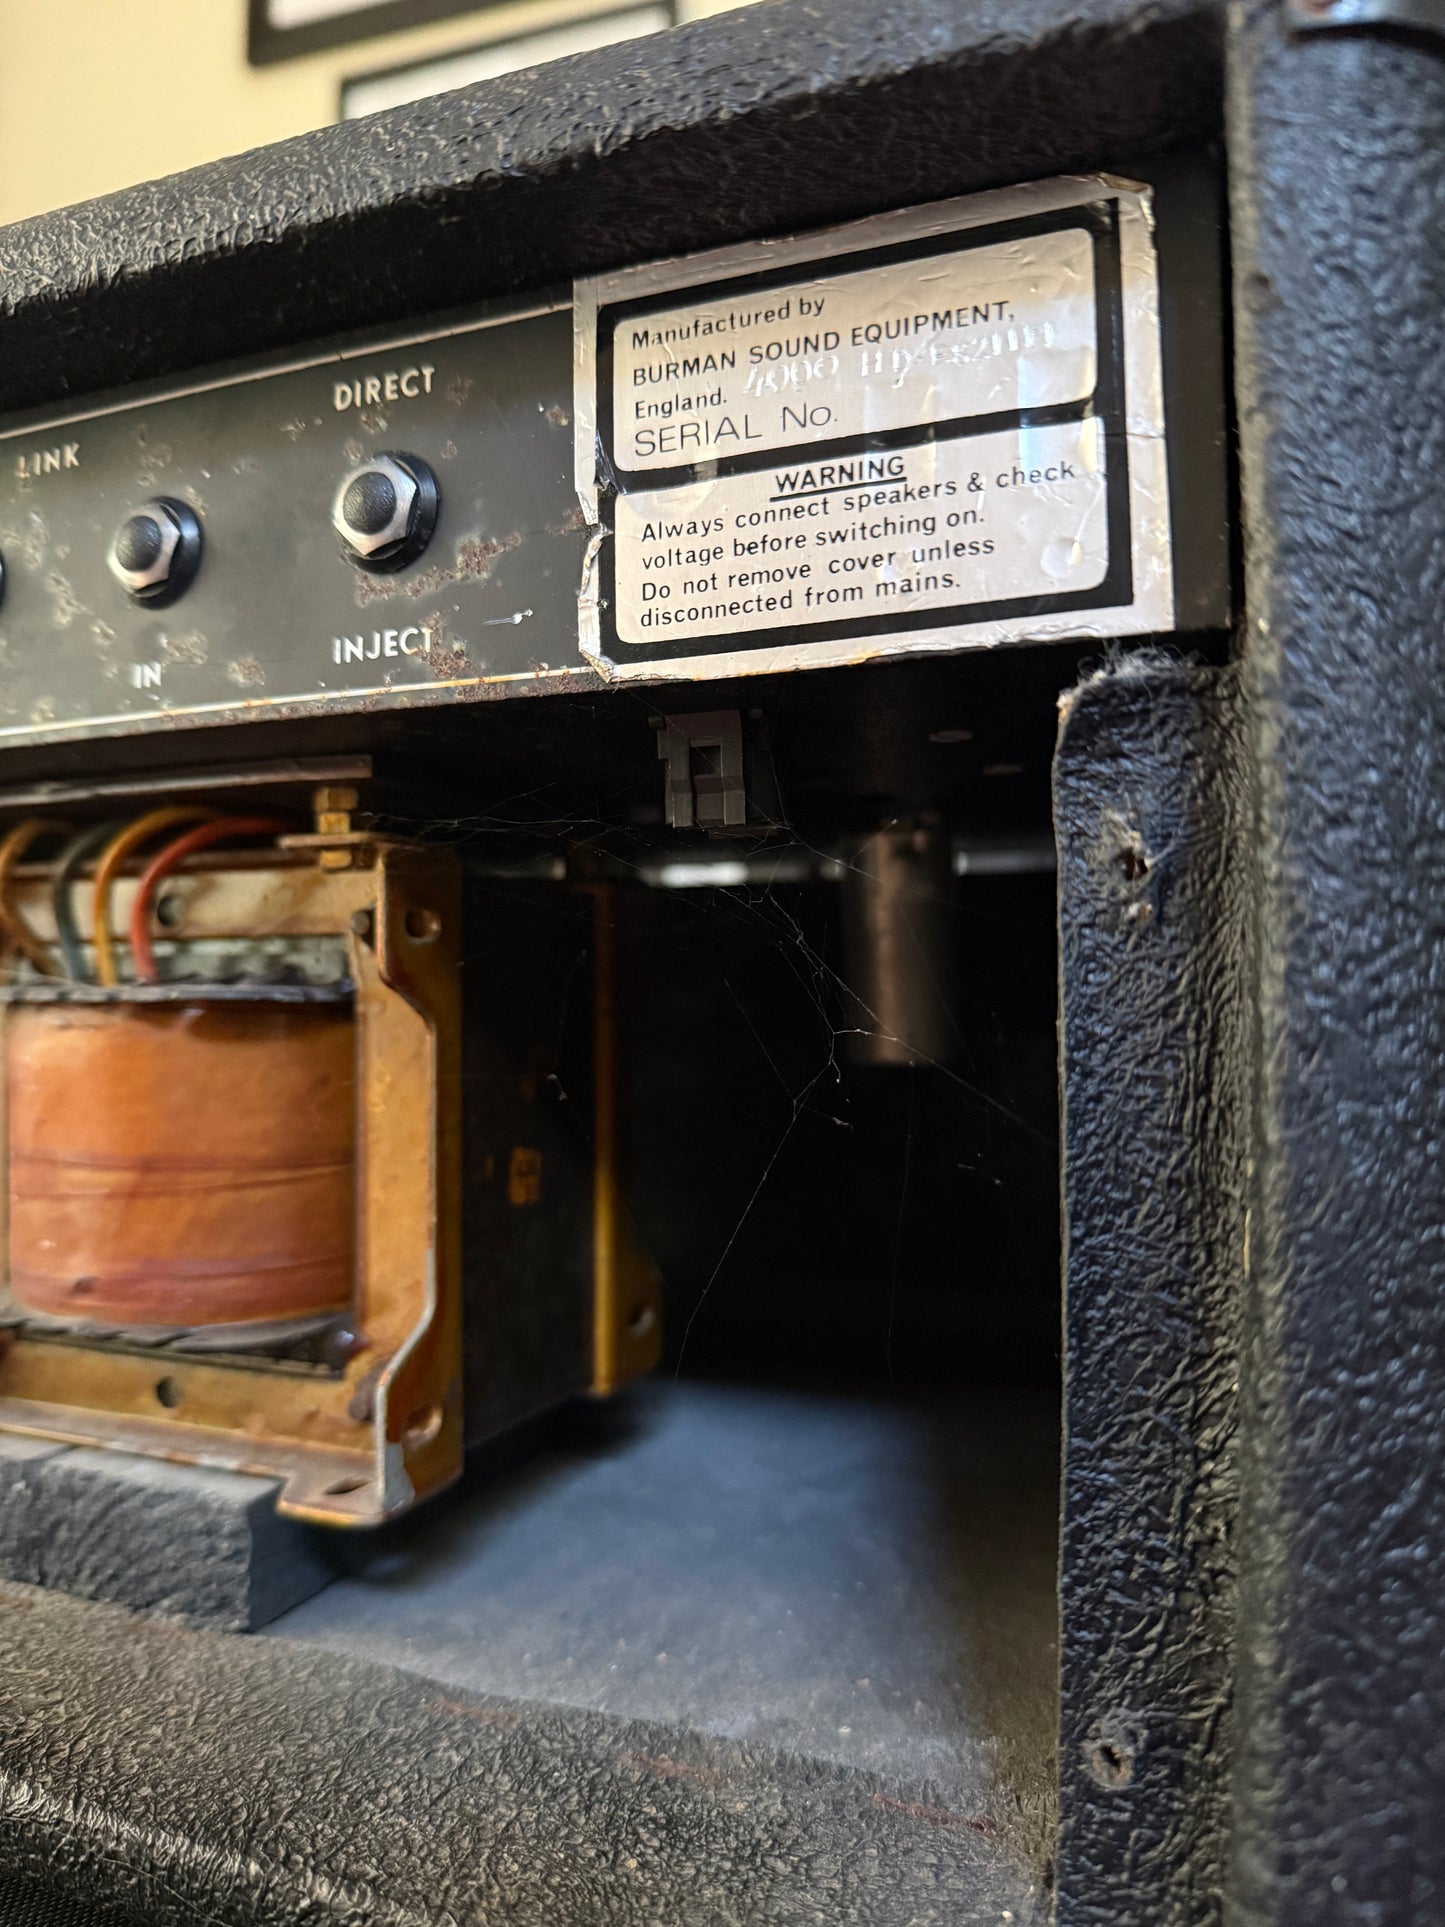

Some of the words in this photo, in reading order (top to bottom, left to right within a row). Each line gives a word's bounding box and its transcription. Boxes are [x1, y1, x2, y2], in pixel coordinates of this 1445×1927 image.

[632, 300, 791, 350] Manufactured
[799, 298, 825, 316] by
[633, 350, 736, 387] BURMAN
[749, 331, 840, 365] SOUND
[851, 300, 1015, 347] EQUIPMENT,
[332, 365, 436, 412] DIRECT
[635, 387, 728, 419] England.
[634, 414, 763, 457] SERIAL
[782, 402, 839, 432] No.
[16, 442, 81, 479] LINK
[775, 456, 905, 493] WARNING
[641, 517, 724, 543] Always
[735, 497, 829, 529] connect
[843, 478, 958, 512] speakers
[966, 472, 985, 493] &
[996, 461, 1076, 488] check
[642, 546, 724, 570] voltage
[733, 534, 807, 557] before
[815, 515, 937, 546] switching
[946, 509, 985, 527] on.
[642, 582, 671, 601] Do
[683, 573, 718, 594] not
[728, 563, 812, 588] remove
[828, 551, 896, 574] cover
[911, 539, 995, 563] unless
[641, 590, 793, 627] disconnected
[805, 584, 863, 606] from
[875, 572, 961, 597] mains.
[332, 626, 434, 664] INJECT
[131, 661, 162, 689] IN
